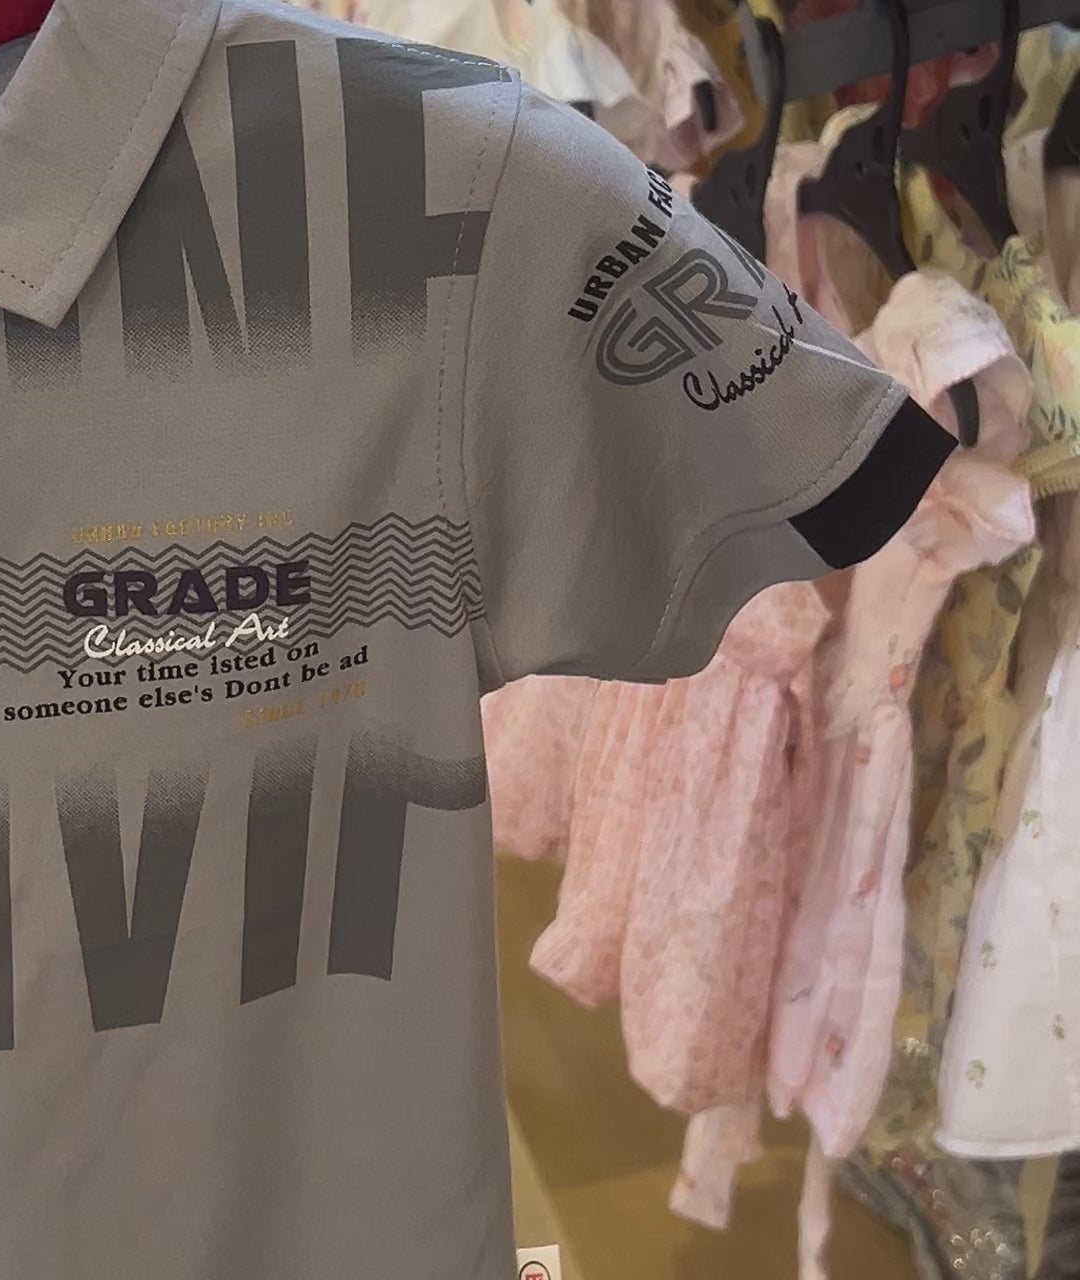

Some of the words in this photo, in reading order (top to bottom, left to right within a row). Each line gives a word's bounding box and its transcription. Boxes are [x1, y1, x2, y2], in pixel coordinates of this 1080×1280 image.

[568, 215, 666, 322] URBAN
[683, 305, 795, 411] Classical
[63, 560, 313, 617] GRADE
[57, 669, 126, 689] Your
[137, 661, 198, 682] time
[286, 641, 319, 662] on
[84, 624, 217, 659] Classical
[225, 613, 289, 648] Art
[4, 696, 128, 721] someone
[138, 685, 214, 708] else's
[224, 672, 291, 699] Dont
[301, 663, 330, 683] be
[339, 645, 369, 671] ad
